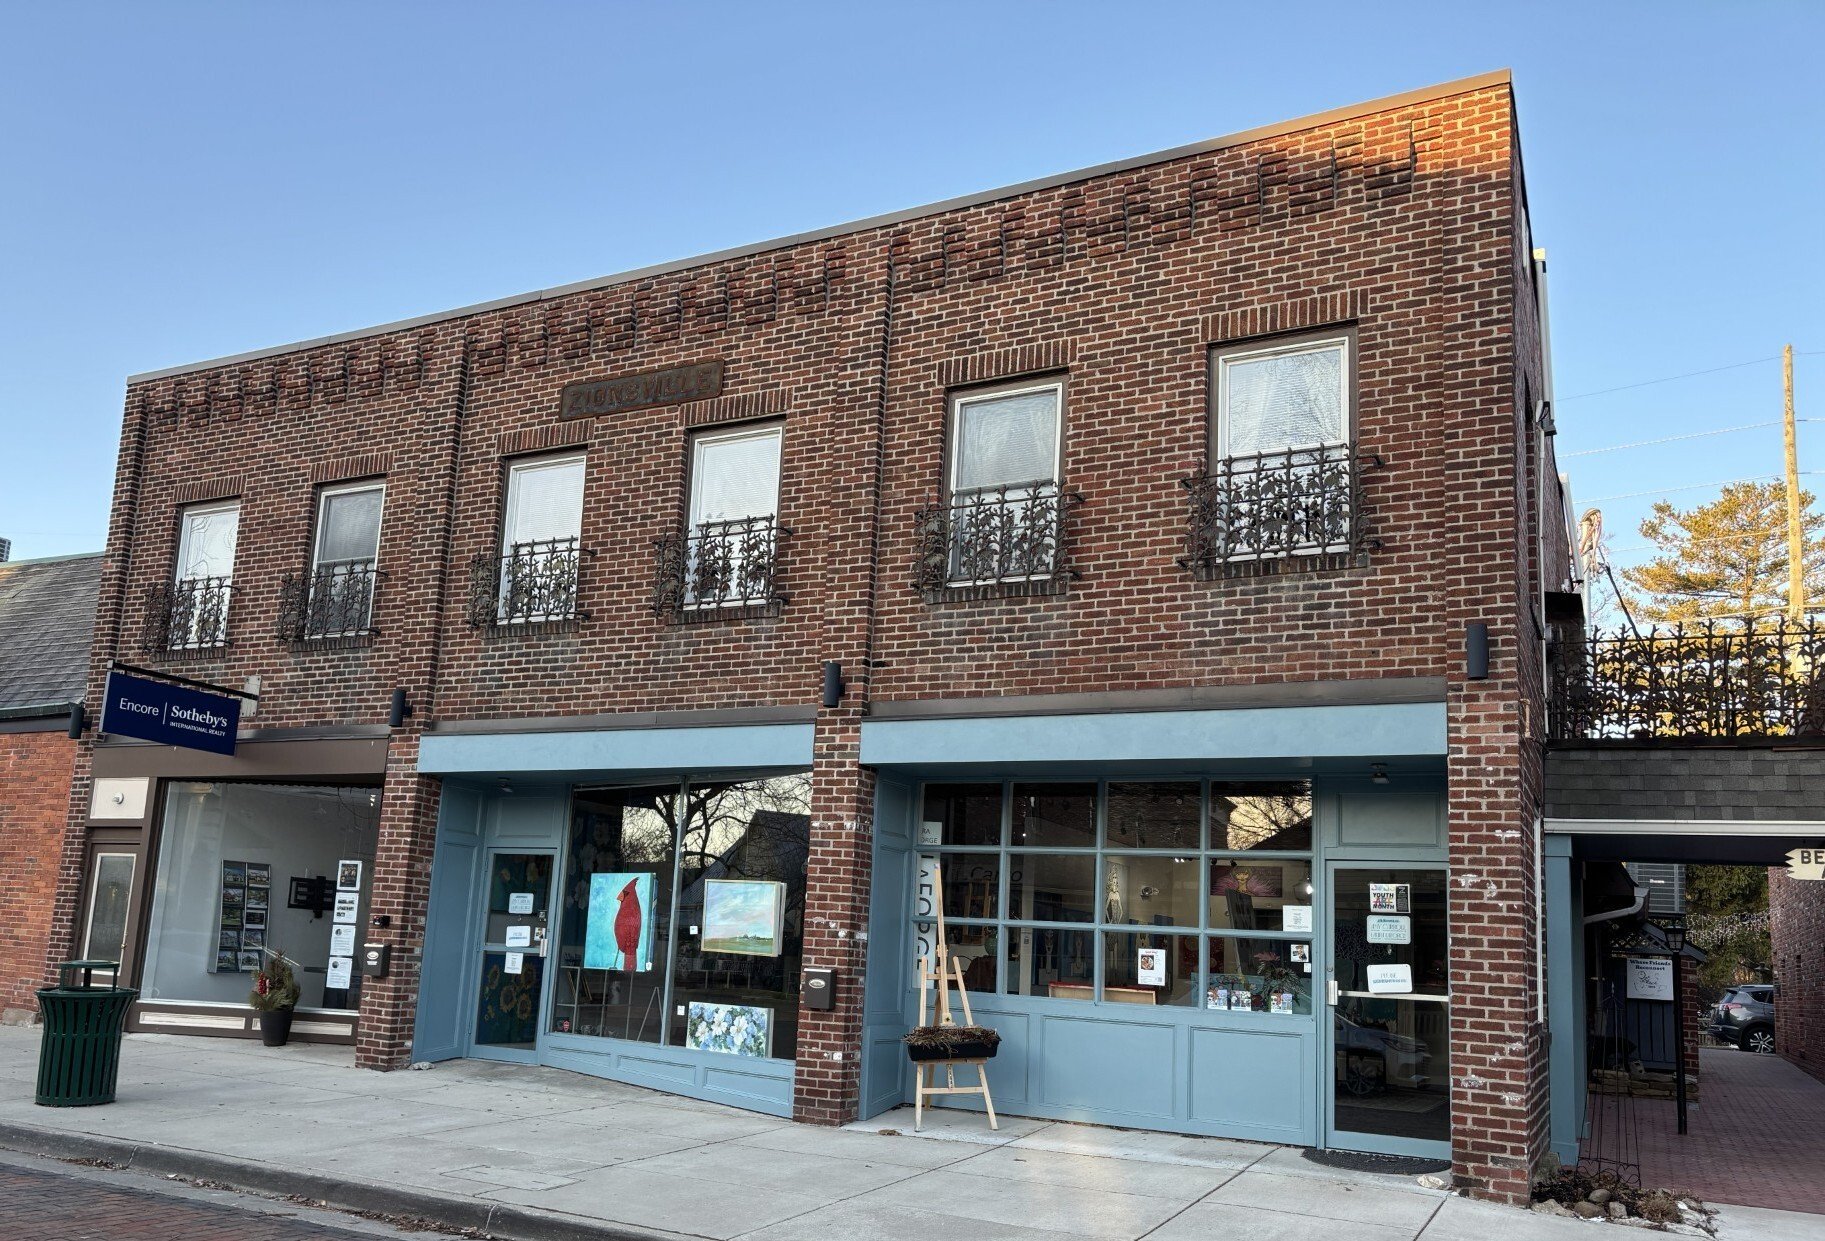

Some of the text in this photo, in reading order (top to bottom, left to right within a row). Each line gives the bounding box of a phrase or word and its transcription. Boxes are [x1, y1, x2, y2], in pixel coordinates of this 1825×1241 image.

[119, 697, 228, 728] Encore Sotheby's
[169, 721, 226, 737] INTERNATIONAL REALTY
